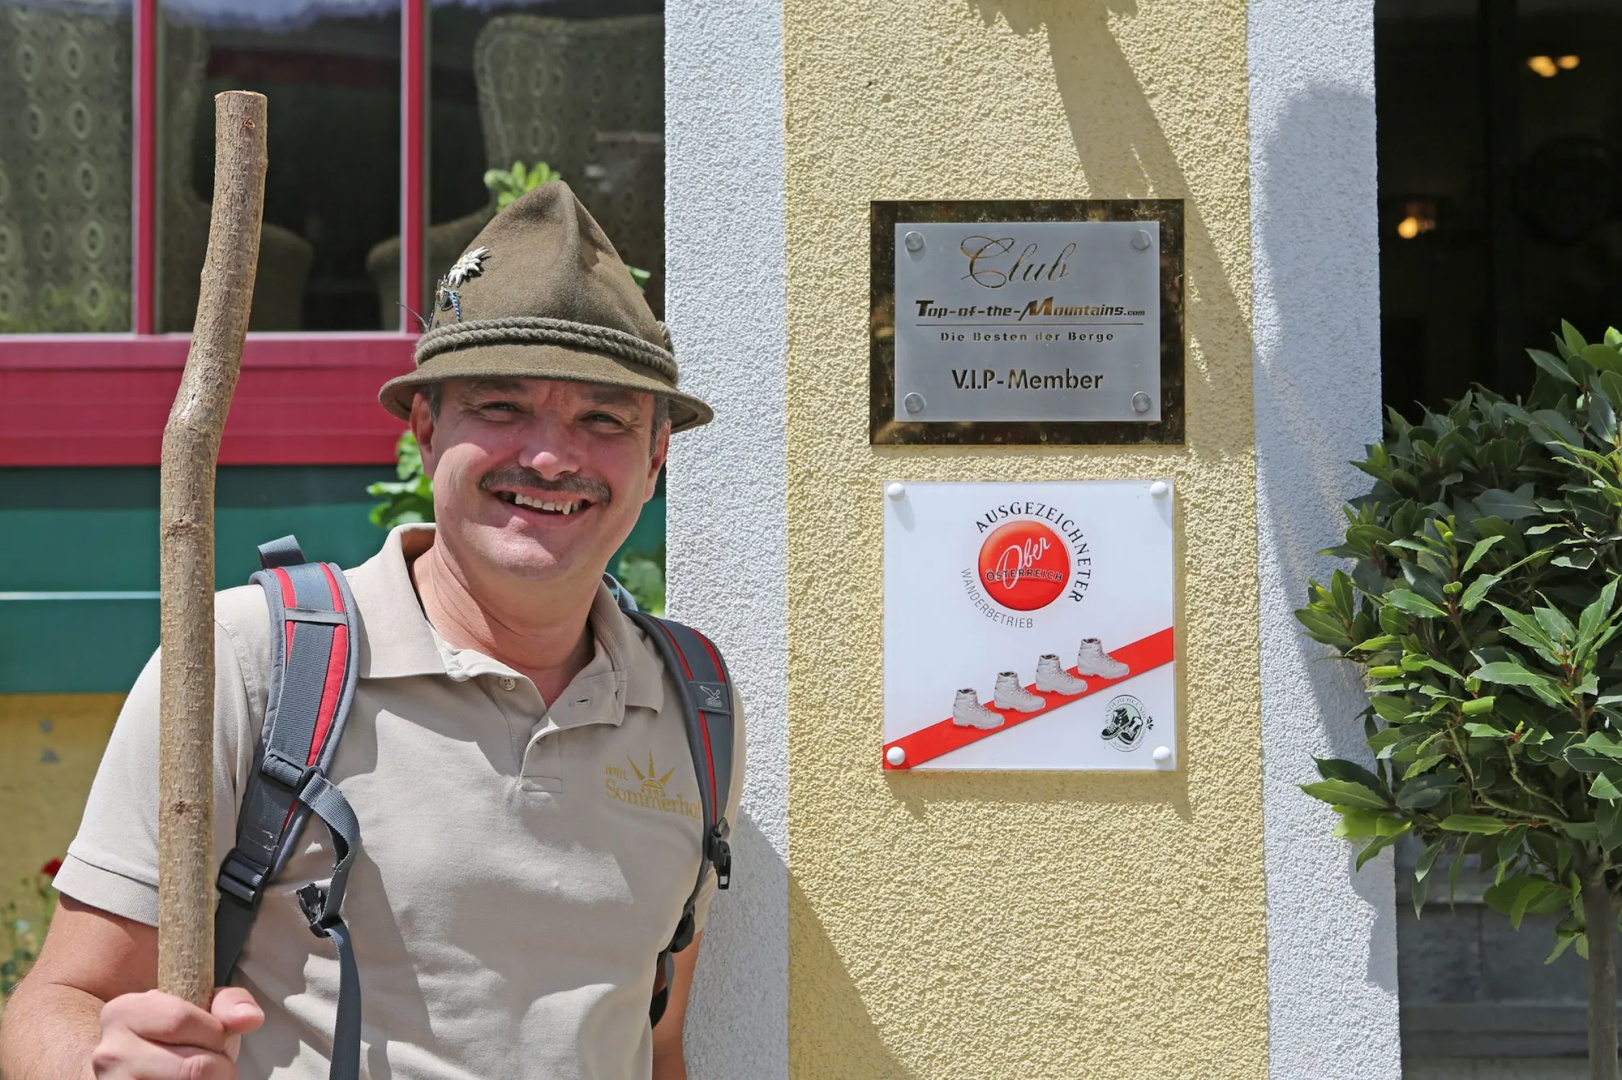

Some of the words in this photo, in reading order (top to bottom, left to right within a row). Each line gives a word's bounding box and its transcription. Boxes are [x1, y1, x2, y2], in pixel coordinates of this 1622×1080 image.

[960, 235, 1077, 289] Club
[940, 332, 965, 342] Die
[973, 332, 1028, 342] Besten
[1035, 332, 1060, 342] der
[1068, 332, 1114, 343] Berge
[951, 368, 1104, 390] V.I.P-Member
[975, 501, 1092, 603] AUSGEZEICHNETER
[986, 567, 1063, 583] ÖSTERREICH
[995, 536, 1051, 590] Ober
[961, 567, 1034, 629] WANDERBETRIEB
